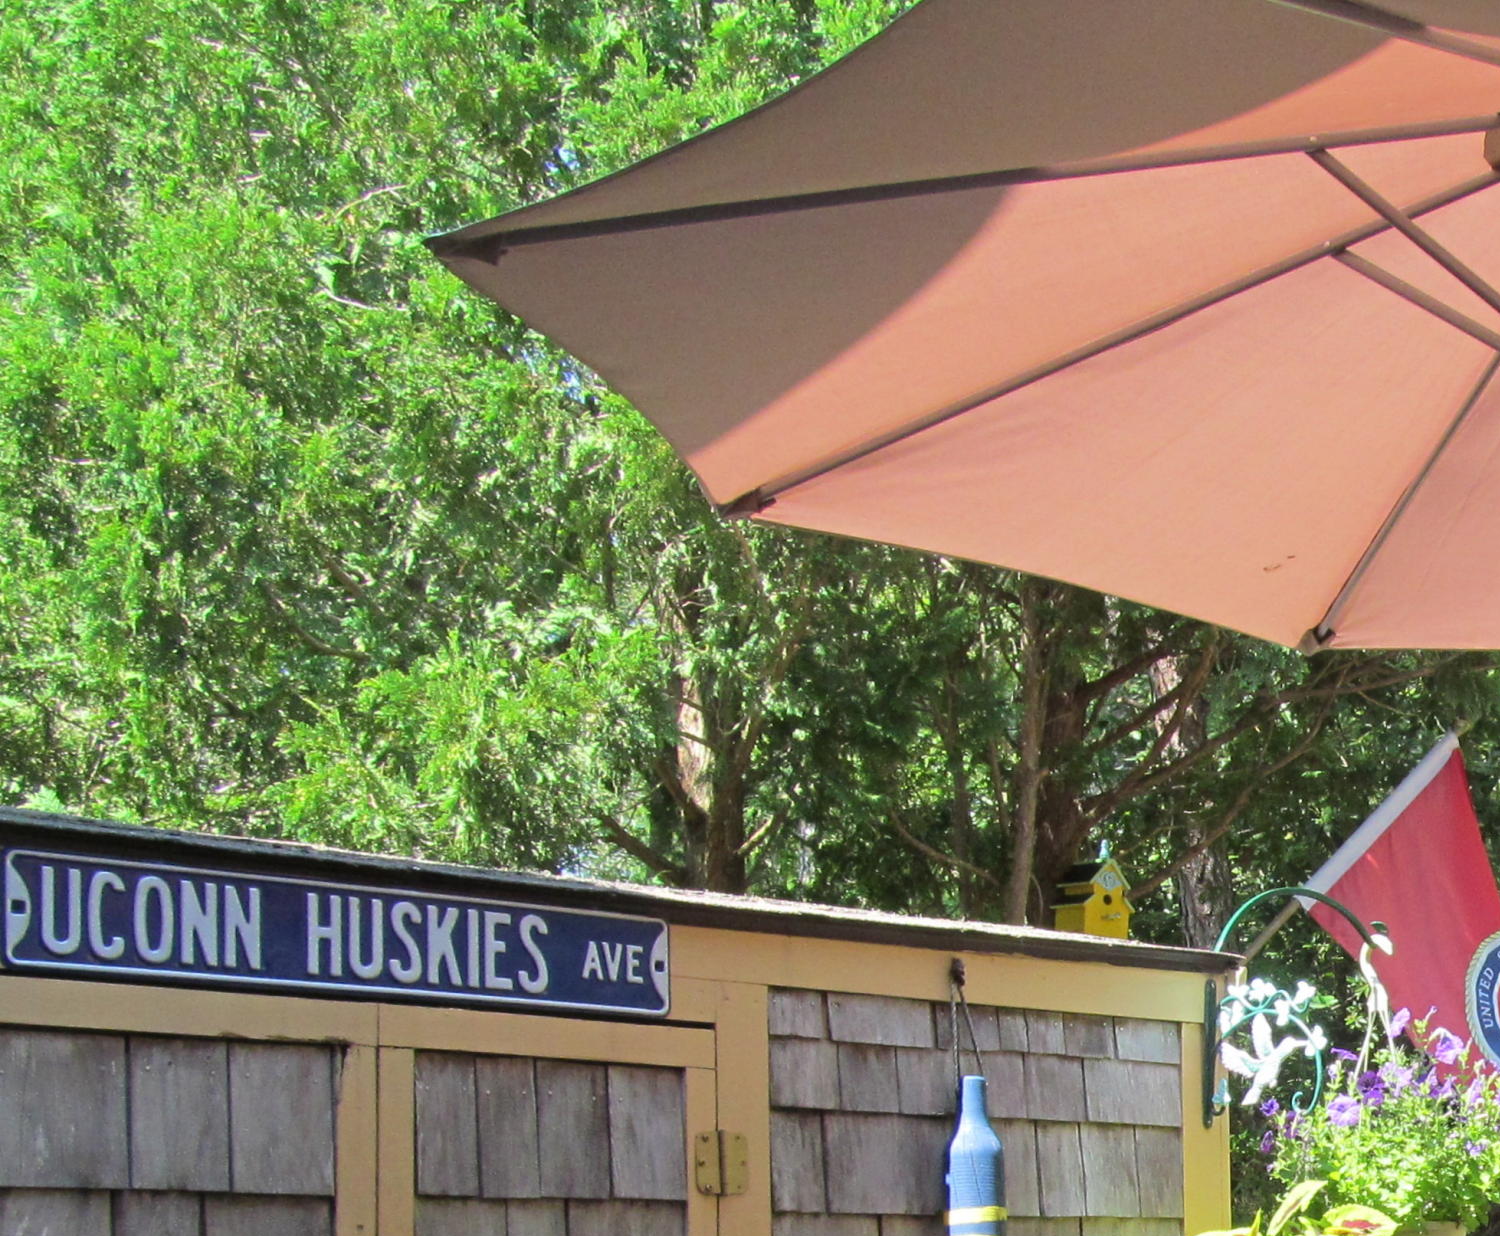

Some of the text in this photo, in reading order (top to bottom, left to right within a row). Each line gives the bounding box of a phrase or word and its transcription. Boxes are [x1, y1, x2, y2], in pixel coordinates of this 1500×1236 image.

[41, 865, 645, 994] UCONN HUSKIES AVE
[1478, 967, 1495, 1029] UNITED
